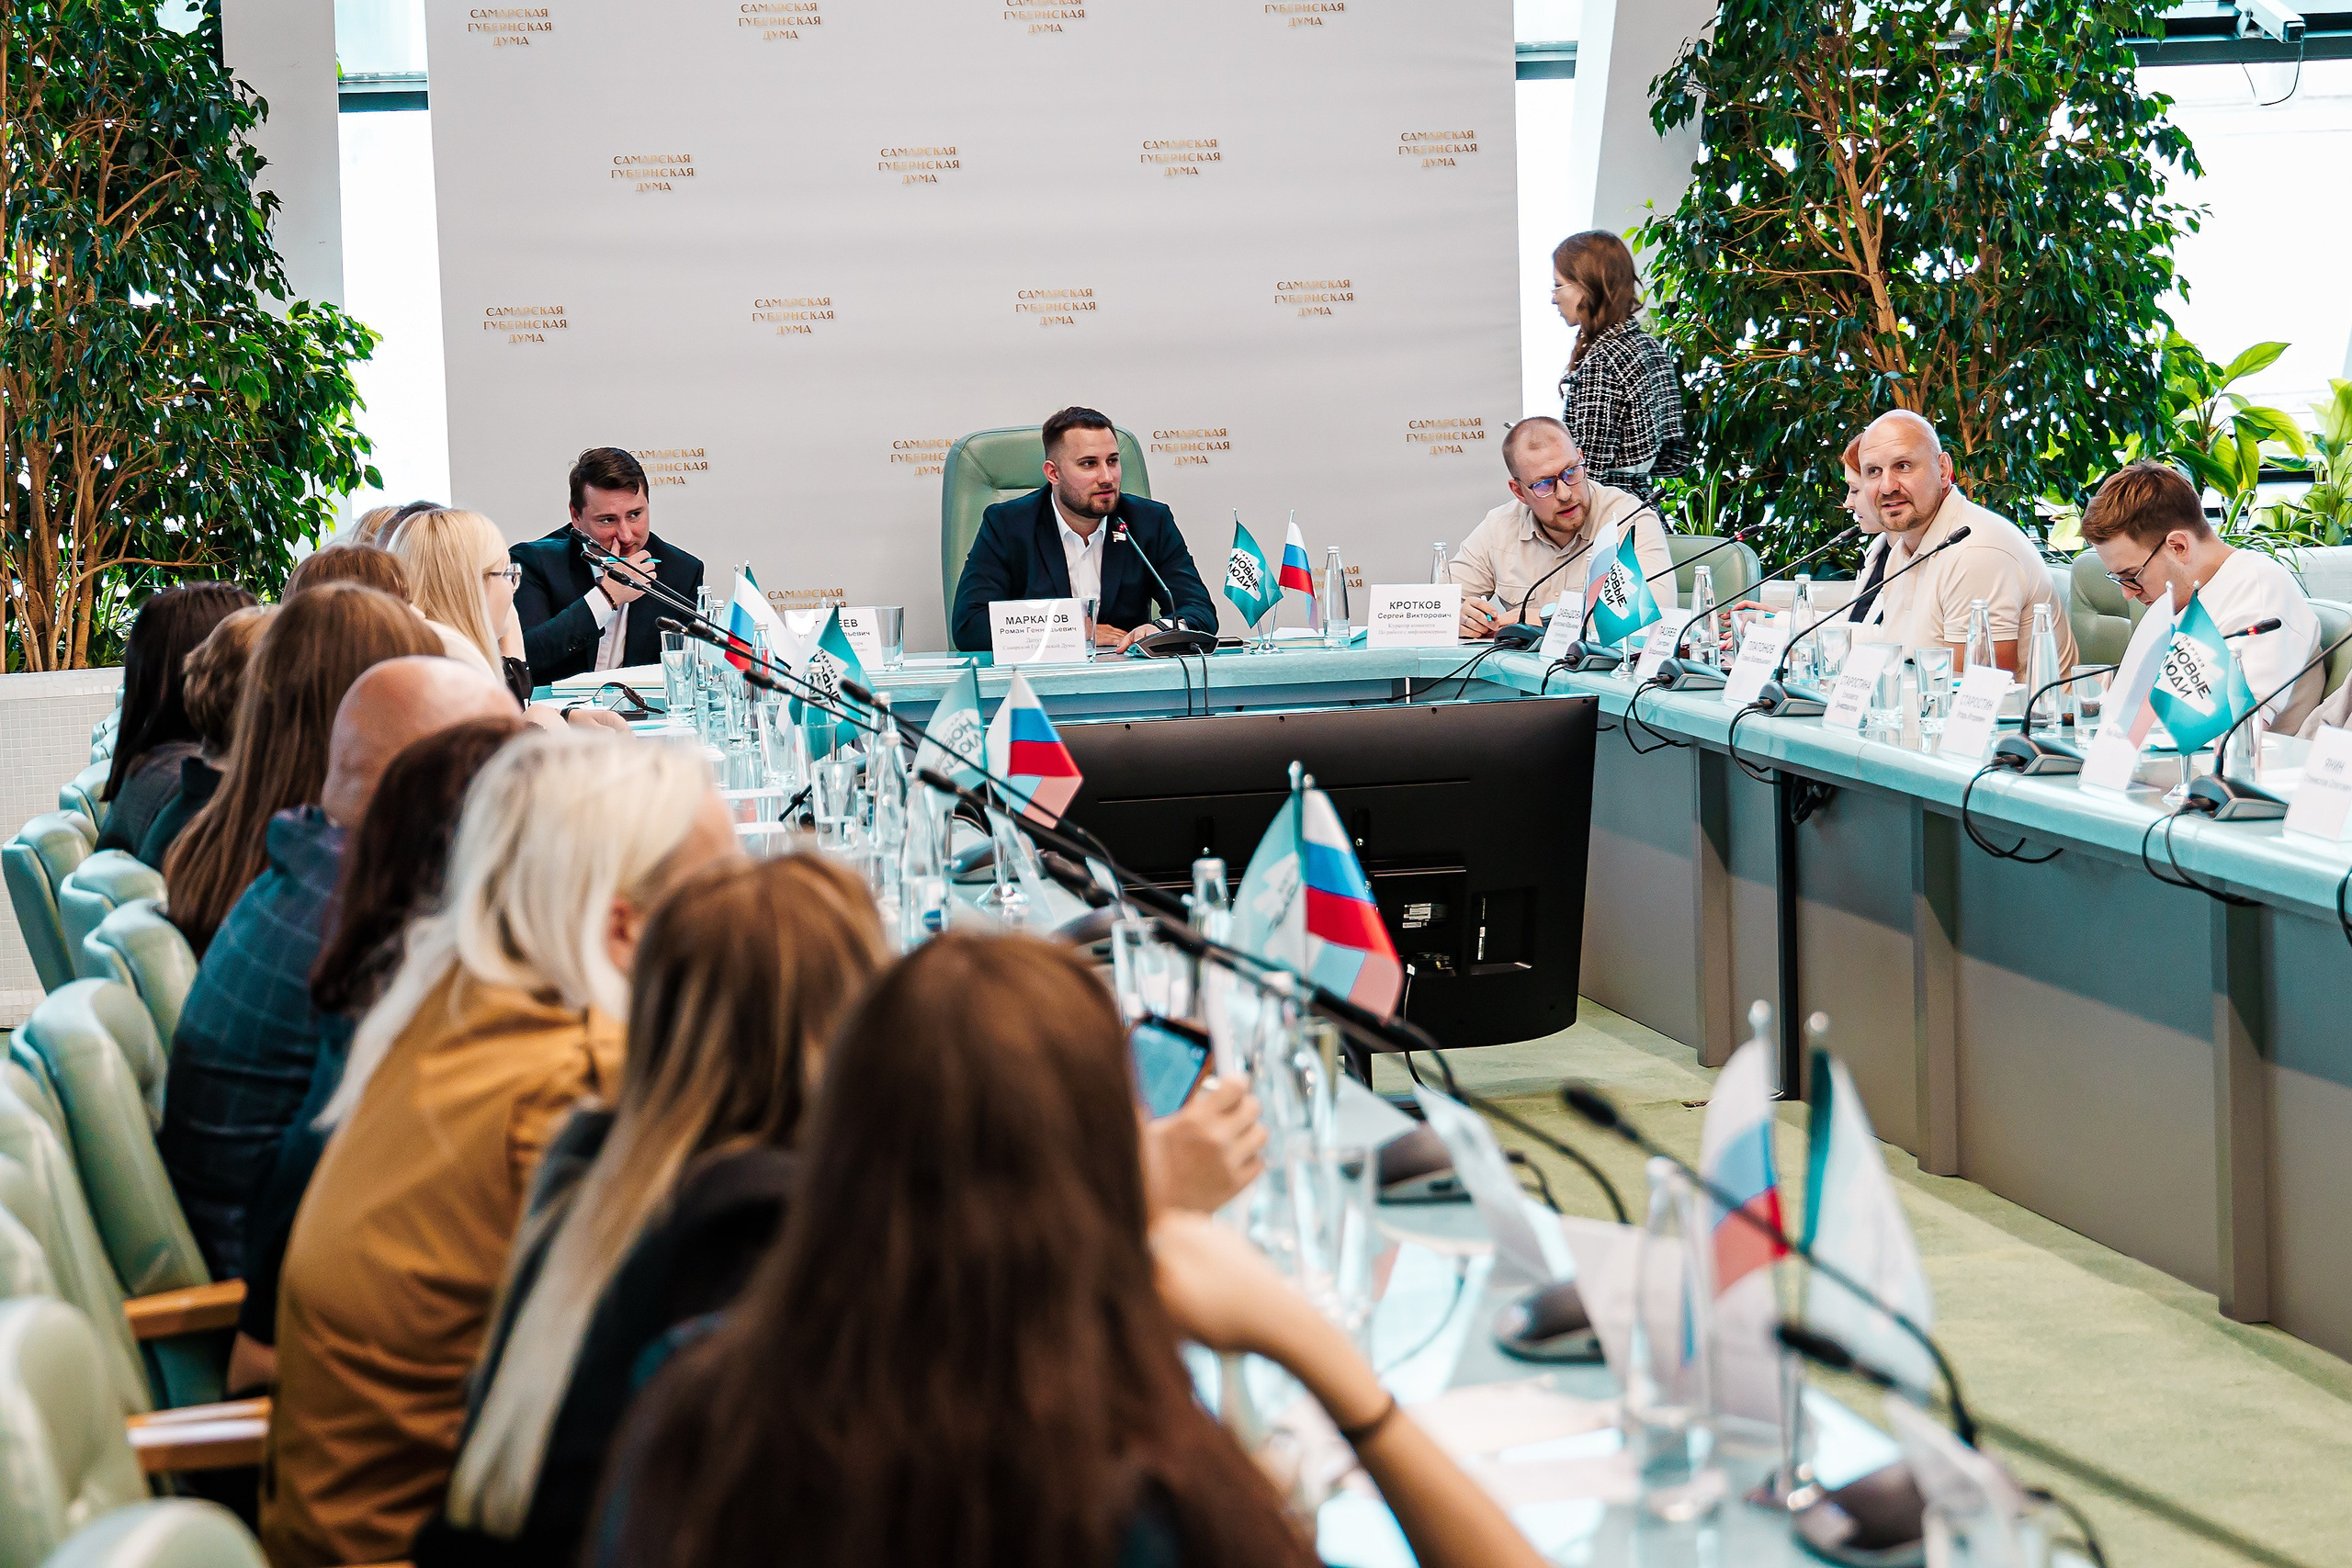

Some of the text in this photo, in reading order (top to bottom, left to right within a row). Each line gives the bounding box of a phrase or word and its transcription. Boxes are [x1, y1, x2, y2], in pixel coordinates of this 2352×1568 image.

[469, 7, 548, 19] САМАРСКАЯ
[740, 2, 819, 13] САМАРСКАЯ
[1263, 2, 1345, 14] ГУБЕРНСКАЯ
[1003, 8, 1086, 20] ГУБЕРНСКАЯ
[467, 21, 552, 33] ГУБЕРНСКАЯ
[738, 15, 822, 27] ГУБЕРНСКАЯ
[1288, 17, 1323, 27] ДУМА
[763, 29, 798, 40] ДУМА
[1027, 23, 1063, 34] ДУМА
[492, 35, 529, 47] ДУМА
[1400, 130, 1475, 141] САМАРСКАЯ
[1142, 139, 1218, 150] САМАРСКАЯ
[1397, 143, 1478, 155] ГУБЕРНСКАЯ
[880, 146, 957, 158] САМАРСКАЯ
[1139, 152, 1221, 164] ГУБЕРНСКАЯ
[613, 153, 692, 165] САМАРСКАЯ
[877, 159, 960, 171] ГУБЕРНСКАЯ
[1420, 157, 1456, 168] ДУМА
[610, 167, 695, 178] ГУБЕРНСКАЯ
[1163, 165, 1199, 176] ДУМА
[901, 173, 937, 185] ДУМА
[635, 181, 672, 192] ДУМА
[1276, 278, 1351, 291] САМАРСКАЯ
[1017, 288, 1094, 299] САМАРСКАЯ
[1273, 292, 1355, 304] ГУБЕРНСКАЯ
[754, 297, 831, 309] САМАРСКАЯ
[1014, 300, 1097, 313] ГУБЕРНСКАЯ
[485, 305, 564, 317] САМАРСКАЯ
[752, 310, 835, 322] ГУБЕРНСКАЯ
[1297, 306, 1332, 318] ДУМА
[482, 319, 569, 331] ГУБЕРНСКАЯ
[1039, 314, 1075, 325] ДУМА
[775, 323, 812, 335] ДУМА
[508, 333, 545, 344] ДУМА
[1408, 417, 1483, 430] САМАРСКАЯ
[1152, 427, 1228, 441] САМАРСКАЯ
[1405, 431, 1486, 444] ГУБЕРНСКАЯ
[892, 438, 958, 450] САМАРСК
[1149, 440, 1231, 453] ГУБЕРНСКАЯ
[1429, 445, 1464, 457] ДУМА
[889, 451, 947, 464] ГУБЕРНС
[1173, 454, 1208, 467] ДУМА
[640, 460, 709, 474] БЕРНСКАЯ
[650, 475, 686, 487] ДУМА
[1227, 563, 1251, 591] ЛЮДИ
[1232, 554, 1260, 591] НОВЫЕ
[1610, 563, 1628, 607] НОВЫЕ
[767, 588, 844, 601] САМАРСКАЯ
[1604, 577, 1615, 606] ЮДИ
[1389, 600, 1442, 610] КРОТКОВ
[1377, 612, 1452, 620] Сергей Викторович
[1026, 626, 1078, 635] Генндьевич
[2162, 654, 2192, 699] ЛЮДИ
[2173, 641, 2211, 700] НОВЫЕ
[1840, 675, 1871, 690] СТАРОСТИНА
[1960, 694, 1995, 710] СТАРОСТИН
[2323, 758, 2346, 774] ЯНИН
